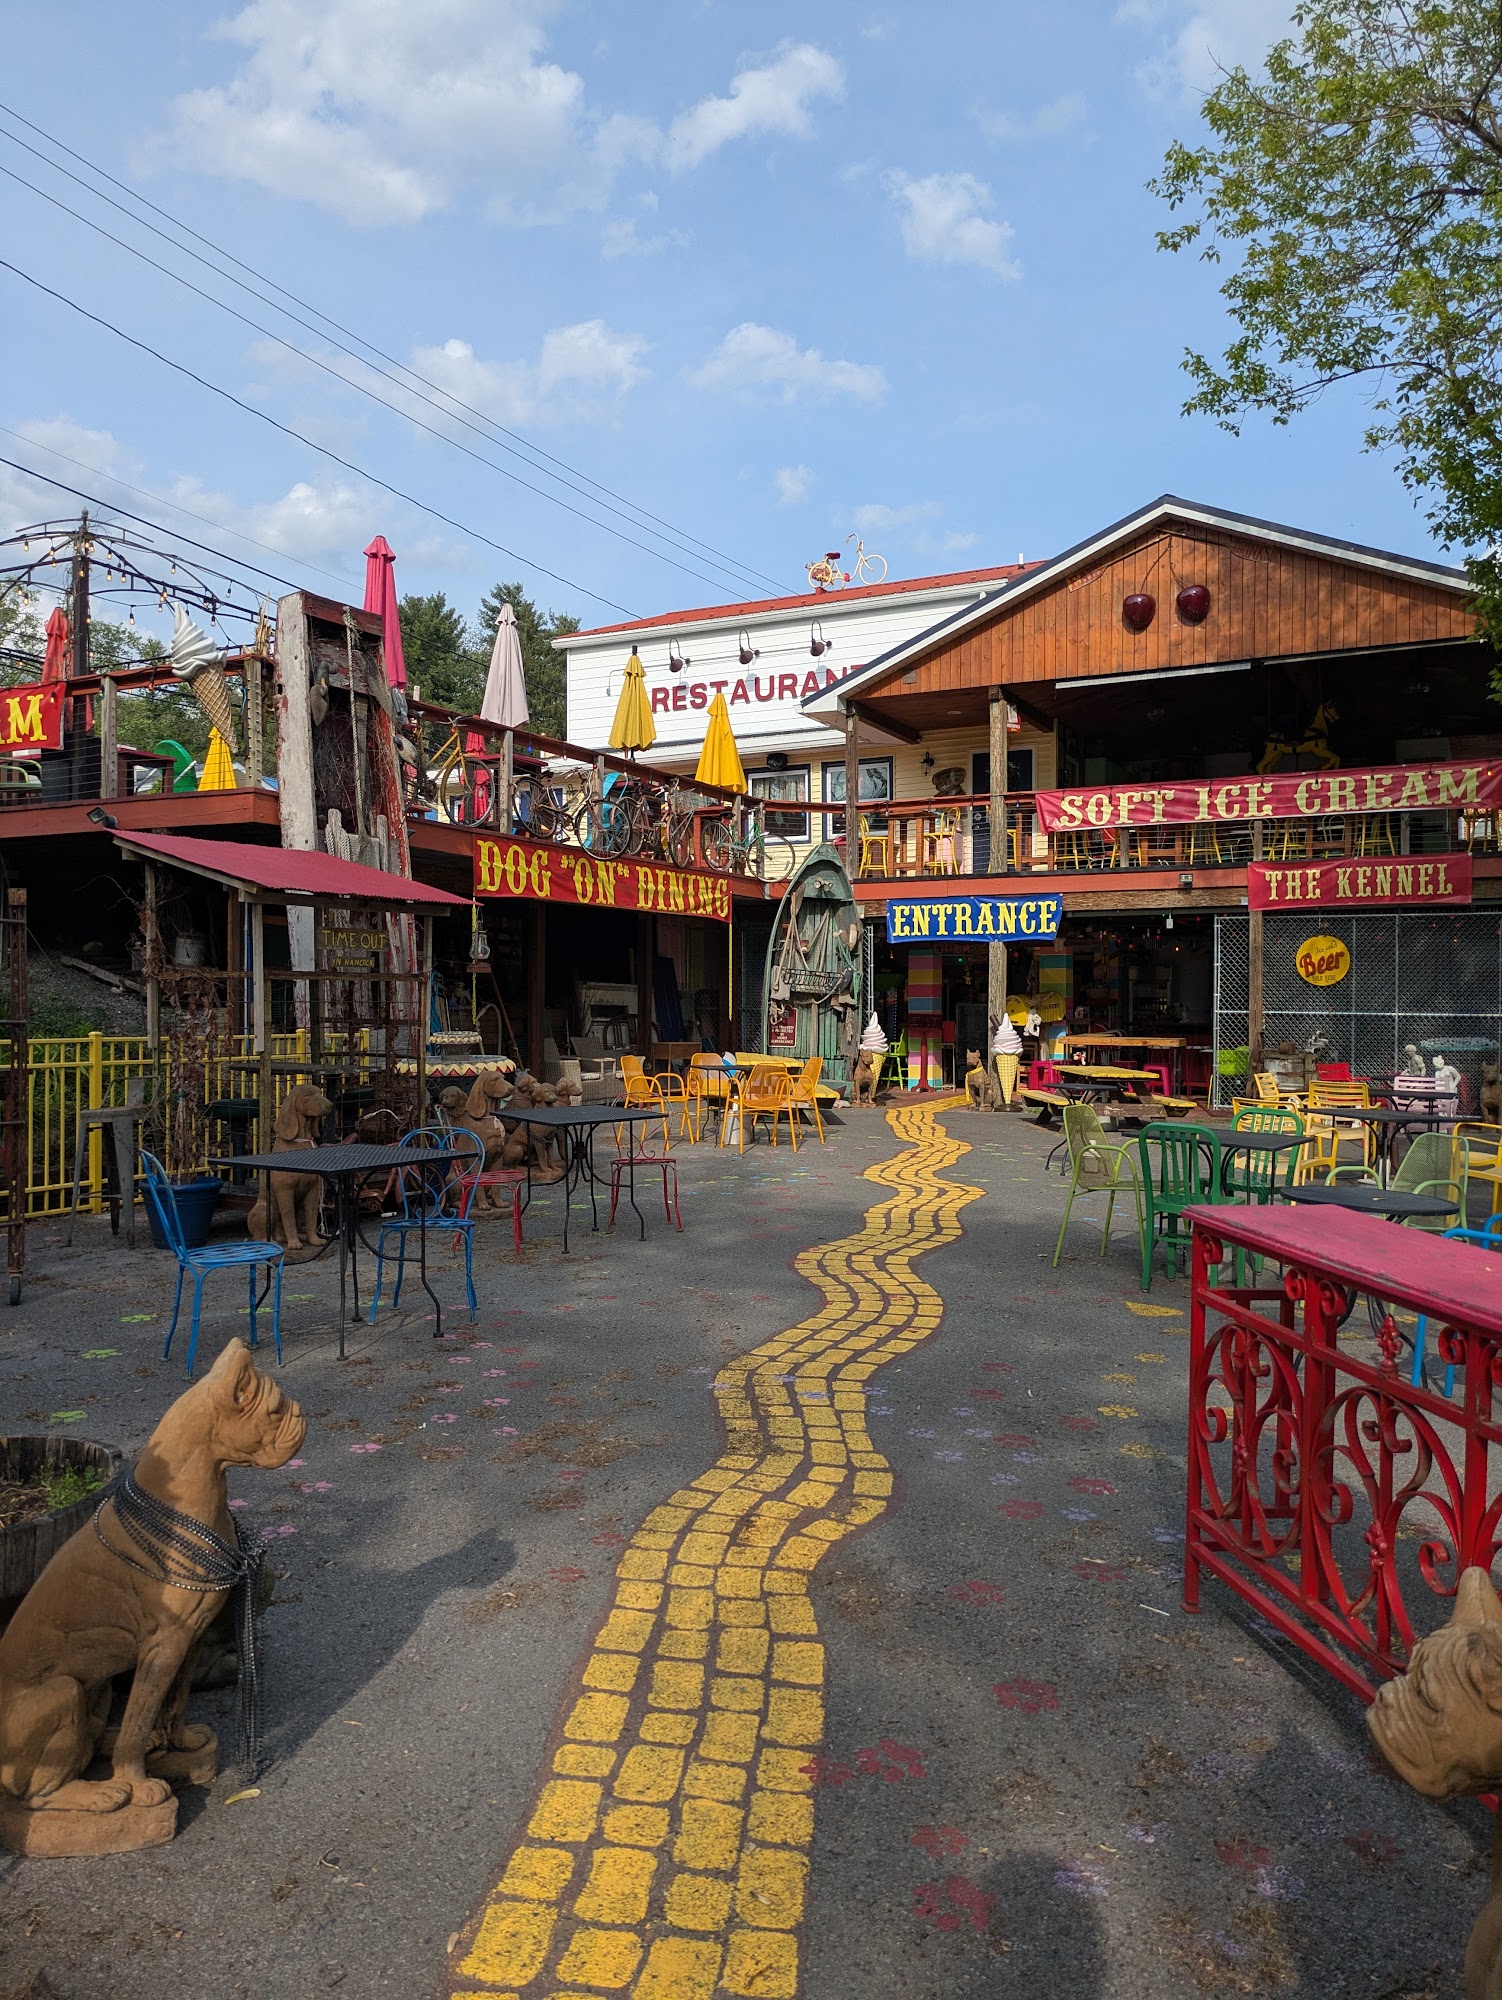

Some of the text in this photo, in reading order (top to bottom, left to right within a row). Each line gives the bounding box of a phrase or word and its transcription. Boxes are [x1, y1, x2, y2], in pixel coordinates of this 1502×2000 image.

[651, 664, 867, 713] RESTAURAN
[0, 693, 47, 744] M
[1059, 767, 1483, 828] SOFT ICE CREAM
[476, 839, 552, 898] DOG
[635, 865, 729, 918] DINING
[1264, 863, 1454, 901] THE KENNEL
[892, 900, 1058, 937] ENTRANCE
[321, 929, 387, 949] TIME OUT
[332, 958, 341, 966] IN
[1299, 951, 1346, 978] Beer
